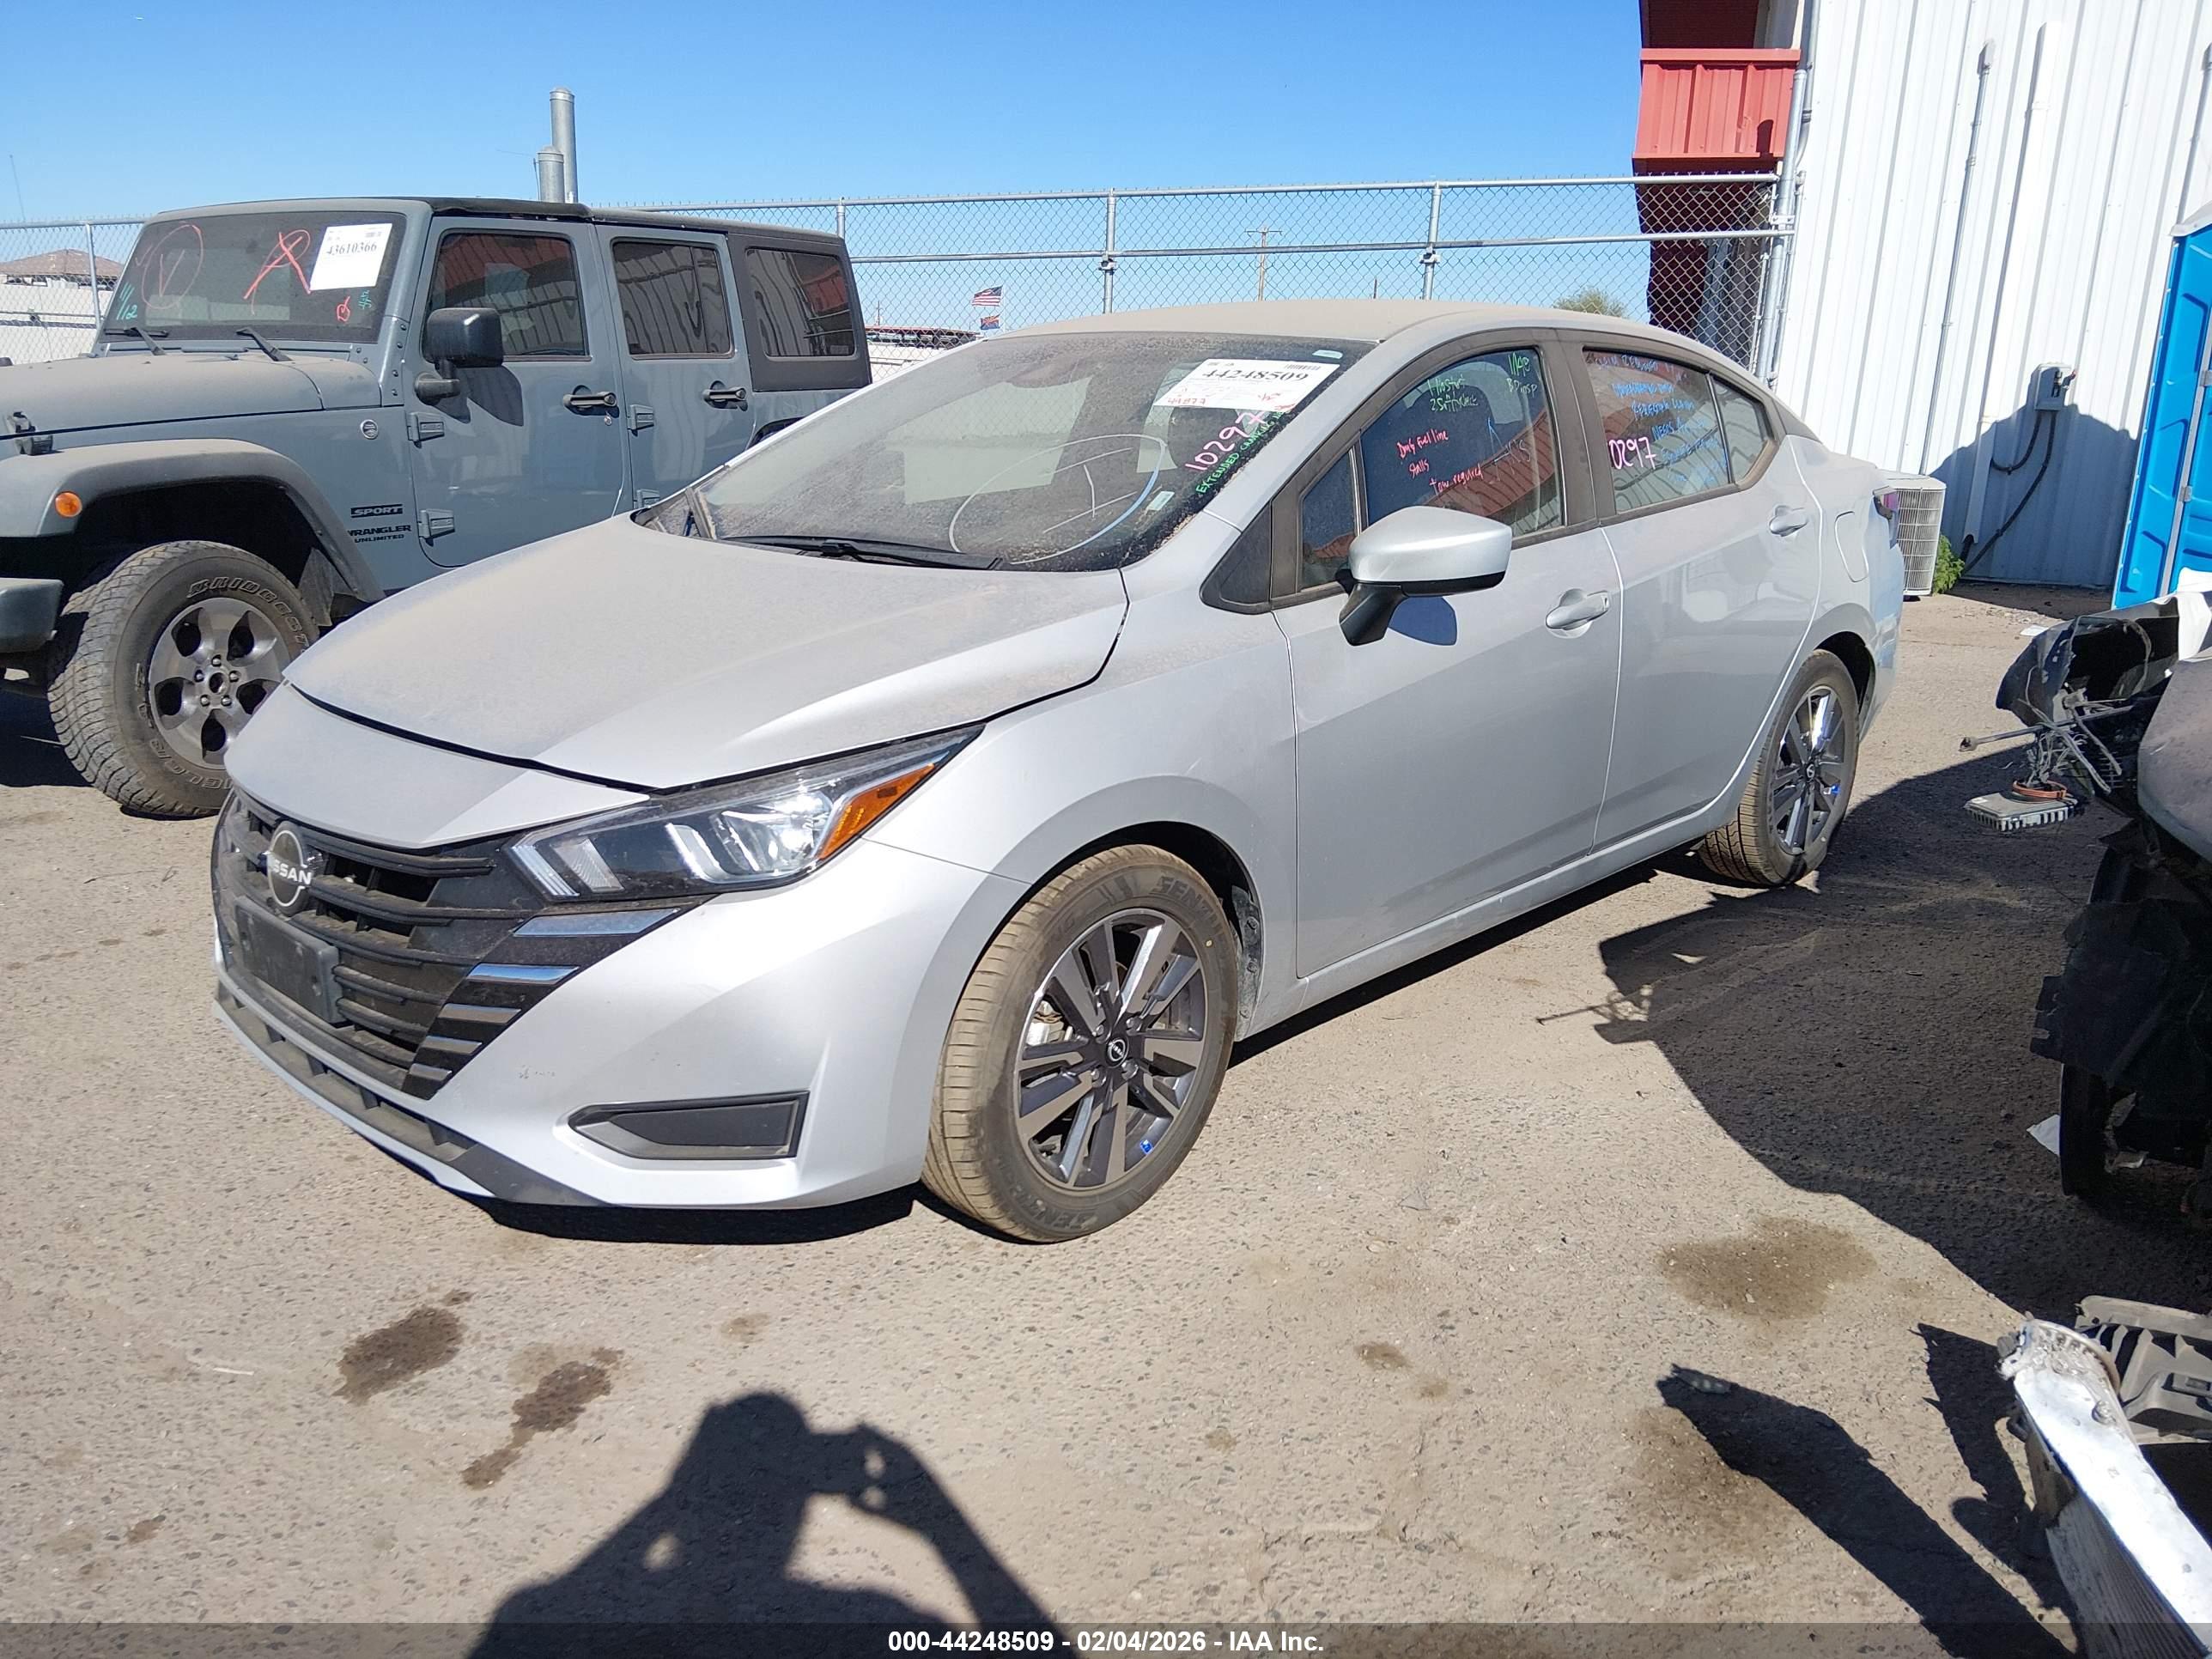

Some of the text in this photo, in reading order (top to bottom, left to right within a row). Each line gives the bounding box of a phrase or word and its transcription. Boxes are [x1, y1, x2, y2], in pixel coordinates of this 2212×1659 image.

[1202, 368, 1309, 381] 44248509
[1195, 453, 1239, 494] EXTENDED
[354, 506, 400, 516] SPORT
[355, 533, 405, 544] UNLIMITED
